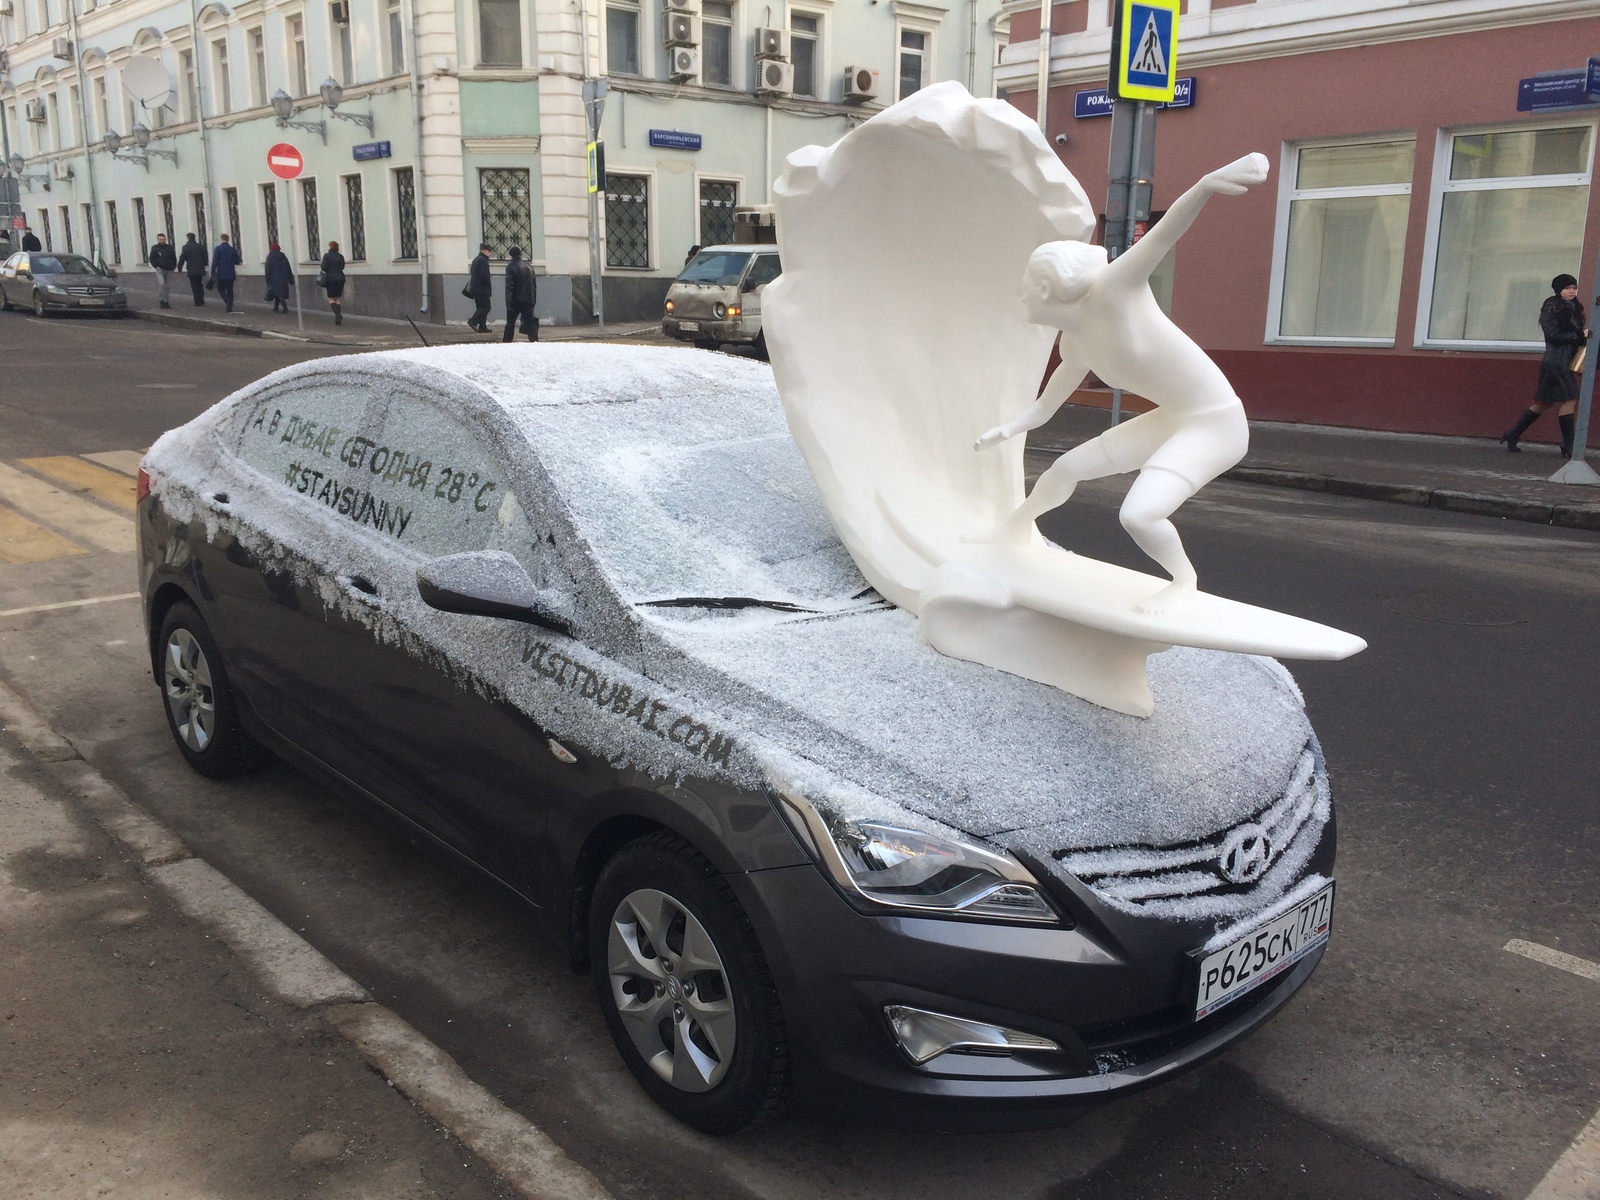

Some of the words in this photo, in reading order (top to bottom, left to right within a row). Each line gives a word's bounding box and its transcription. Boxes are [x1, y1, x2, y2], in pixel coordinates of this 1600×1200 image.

[253, 408, 268, 432] А
[268, 409, 282, 436] В
[280, 415, 341, 458] ДУБАЕ
[340, 436, 432, 492] СЕГОДНЯ
[284, 460, 413, 539] #STAYSUNNY
[521, 641, 736, 769] VISITDUBAI.COM
[1300, 892, 1328, 936] 777
[1303, 926, 1319, 944] RUS
